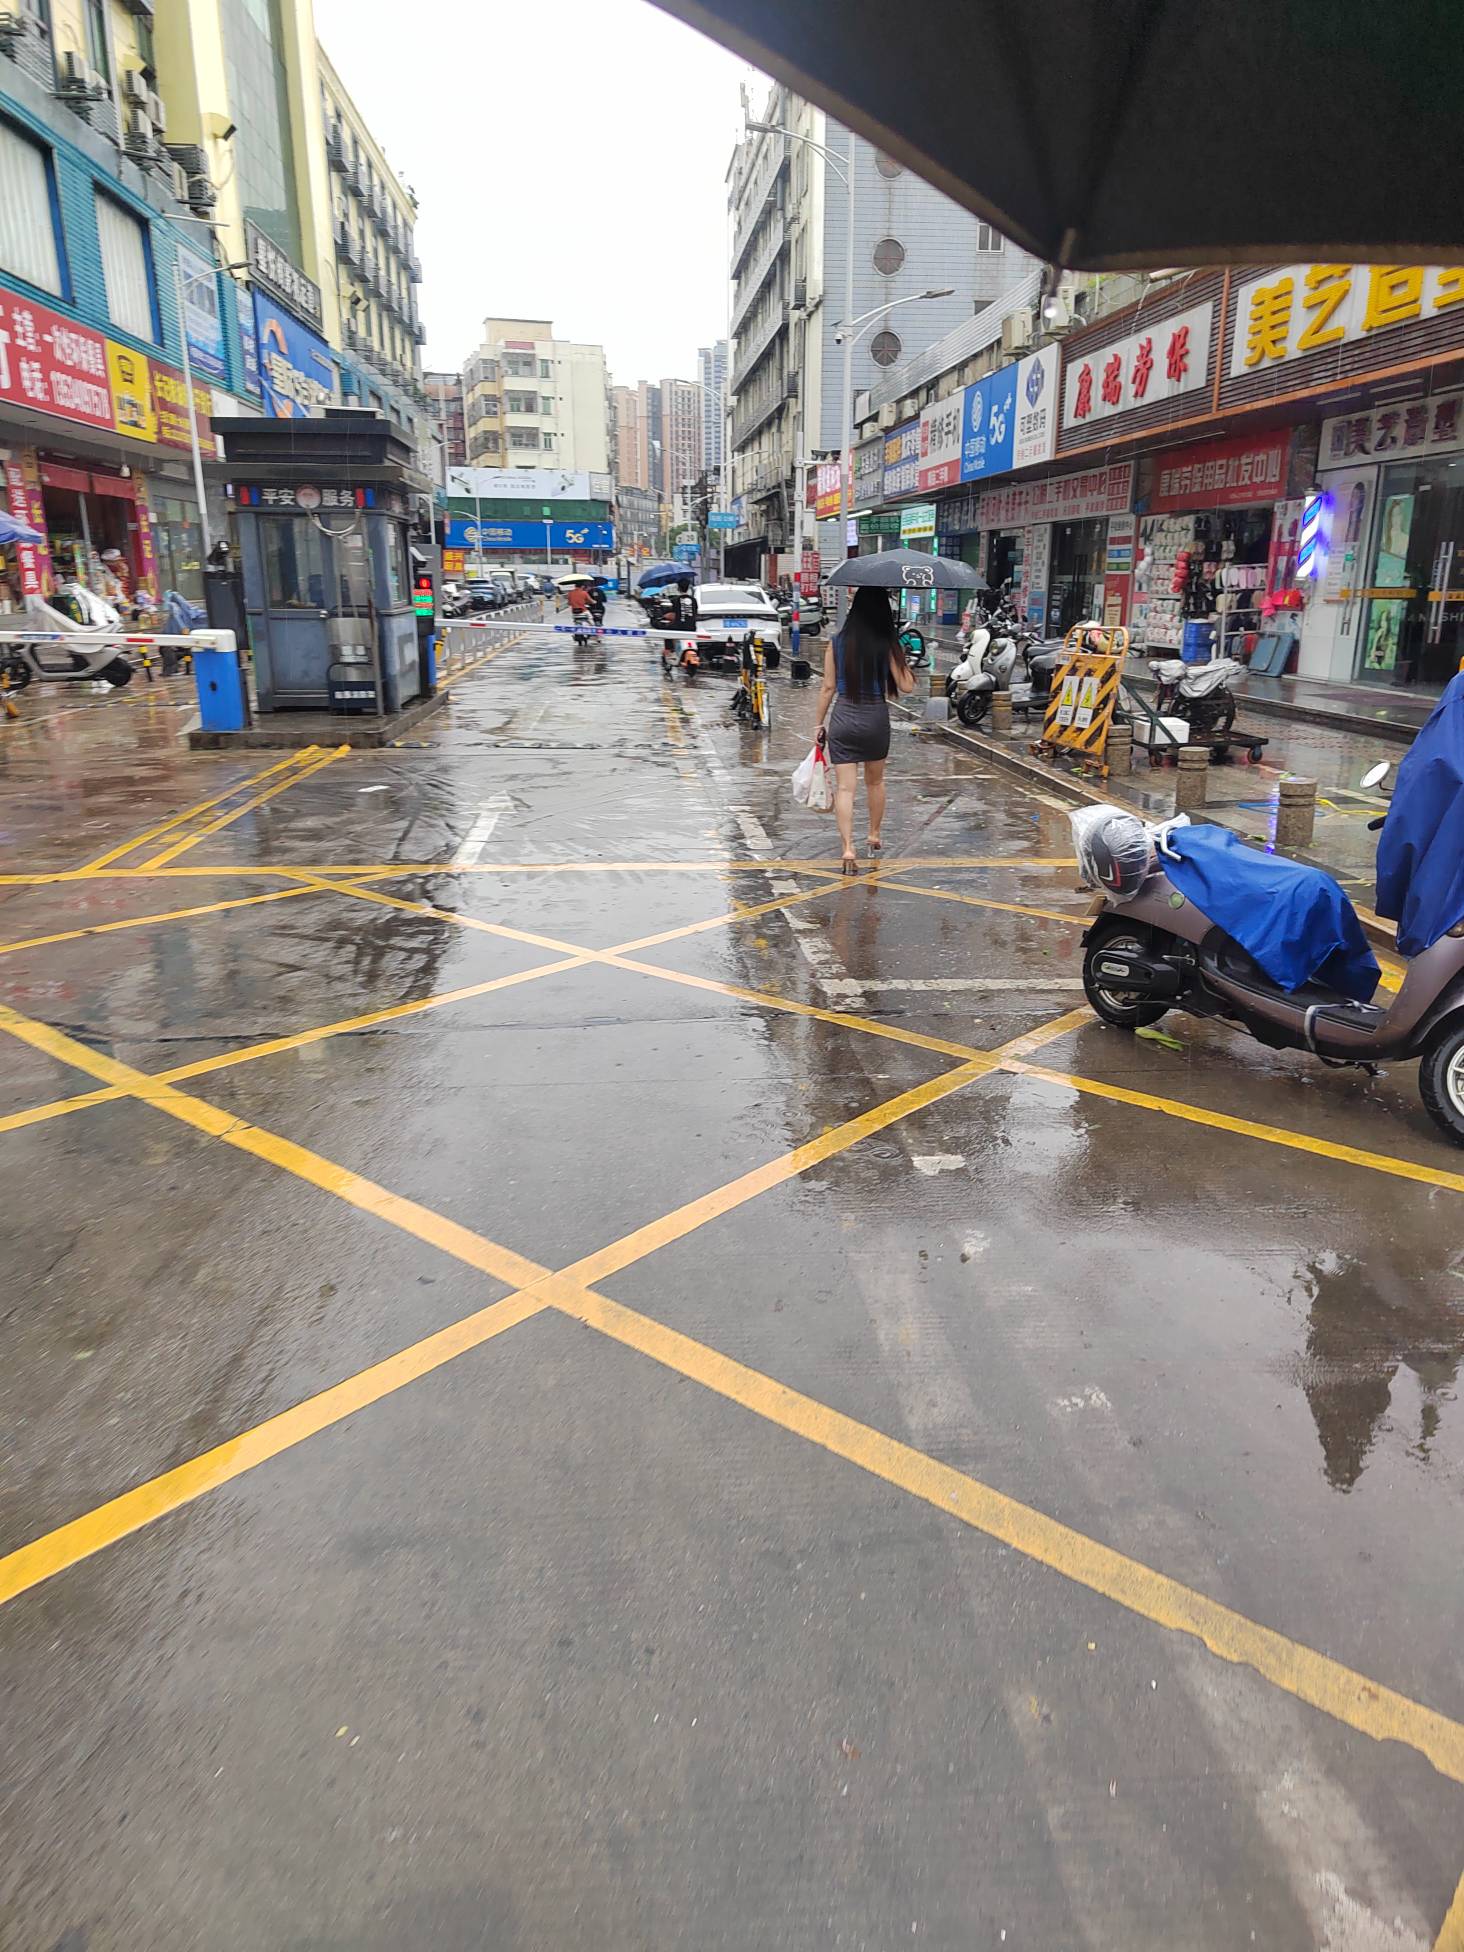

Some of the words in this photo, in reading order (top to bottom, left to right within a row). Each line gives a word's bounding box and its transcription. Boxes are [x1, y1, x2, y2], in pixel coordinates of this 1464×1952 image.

[262, 488, 295, 506] 平安
[322, 489, 355, 507] 服务
[564, 529, 585, 544] 5G
